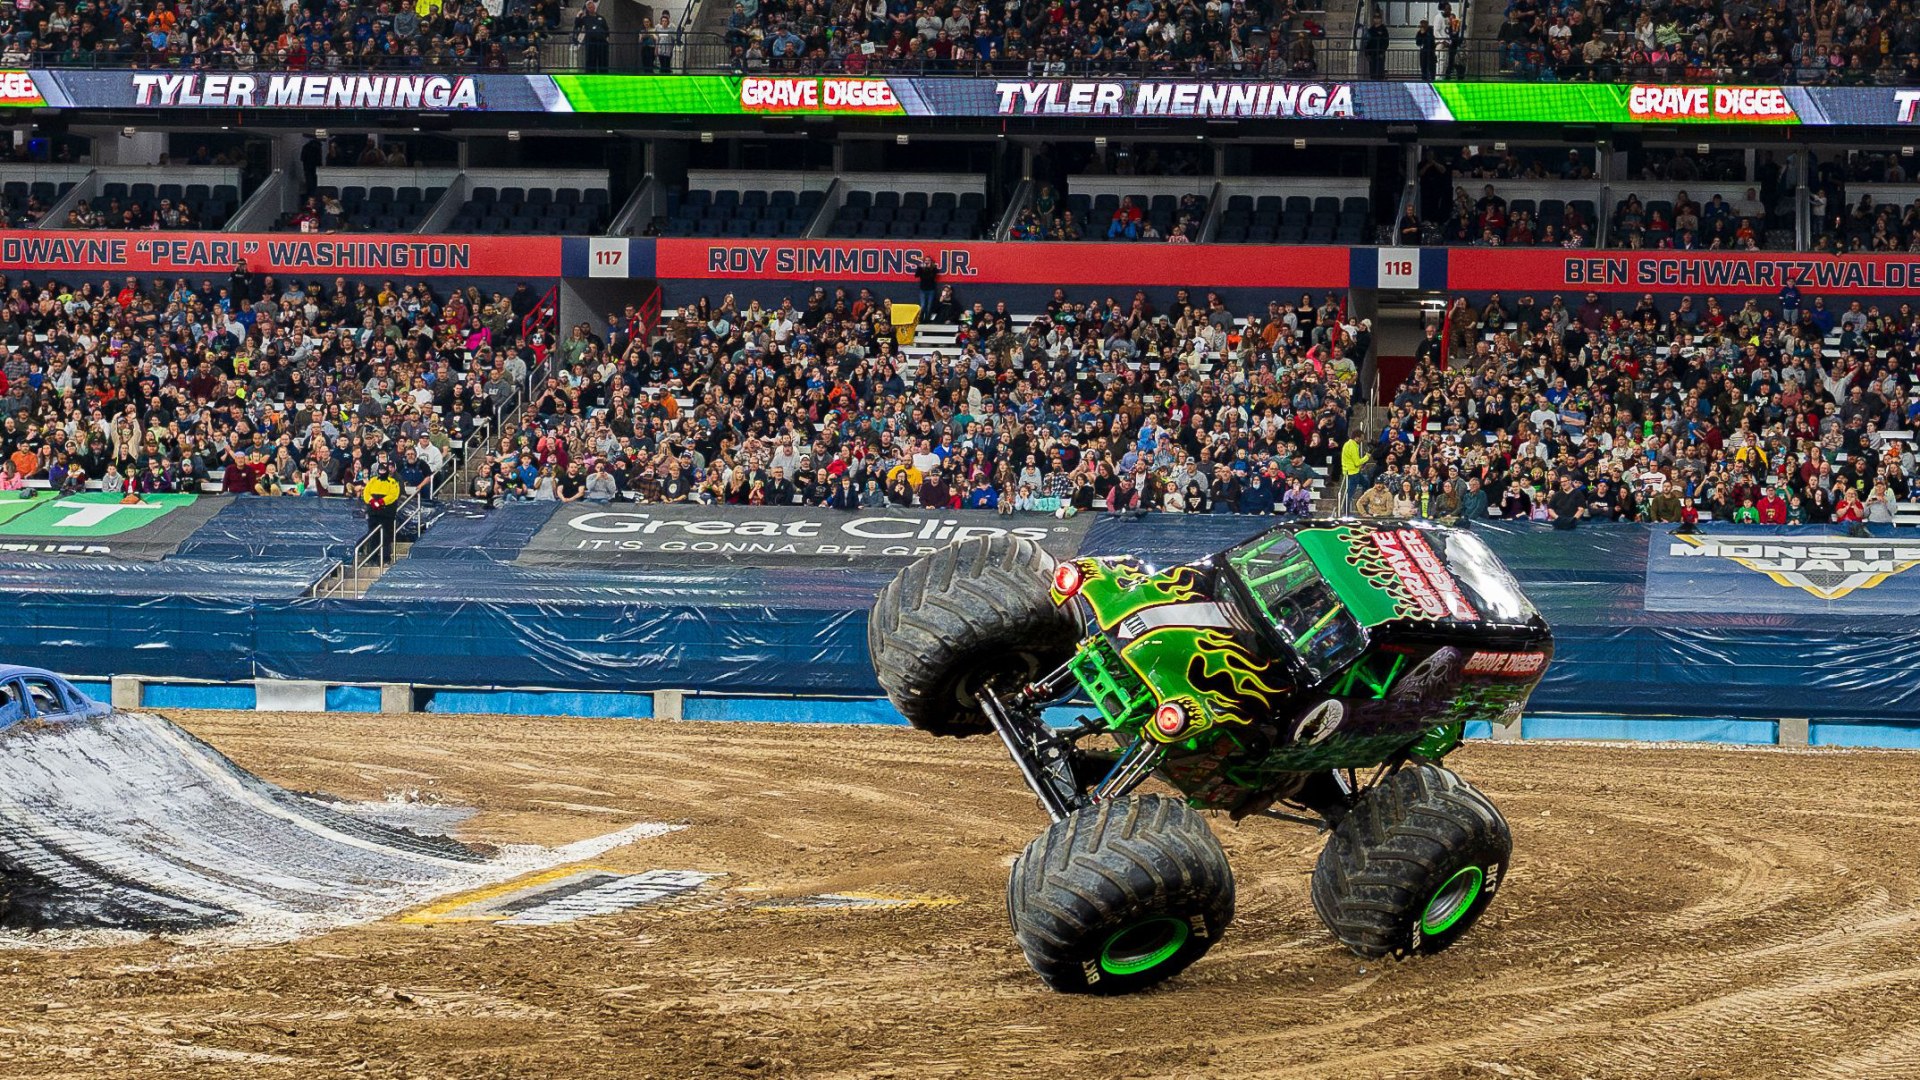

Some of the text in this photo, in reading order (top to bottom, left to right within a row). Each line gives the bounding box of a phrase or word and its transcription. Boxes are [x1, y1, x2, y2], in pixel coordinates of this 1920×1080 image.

[132, 74, 477, 108] TYLER MENNINGA
[742, 79, 817, 105] GRAVE
[996, 82, 1353, 117] TYLER MENNINGA
[1630, 87, 1708, 114] GRAVE
[3, 238, 127, 264] DWAYNE
[268, 241, 470, 268] WASHINGTON
[596, 251, 622, 265] 117
[708, 247, 977, 276] ROY SIMMONS JR.
[1385, 261, 1412, 275] 118
[1564, 258, 1628, 284] BEN
[568, 512, 1049, 541] Great Clips
[577, 539, 643, 551] IT'S
[654, 541, 797, 554] GONNA
[815, 544, 866, 555] BE
[1371, 530, 1450, 619] GRAVE
[1397, 529, 1479, 622] DIGGER
[1752, 558, 1894, 573] JAM
[1464, 651, 1545, 672] GRAVE DIGGER
[1485, 862, 1499, 893] BKT
[1190, 914, 1209, 938] BKT
[1412, 919, 1422, 950] BKT
[1082, 958, 1101, 985] BKT
